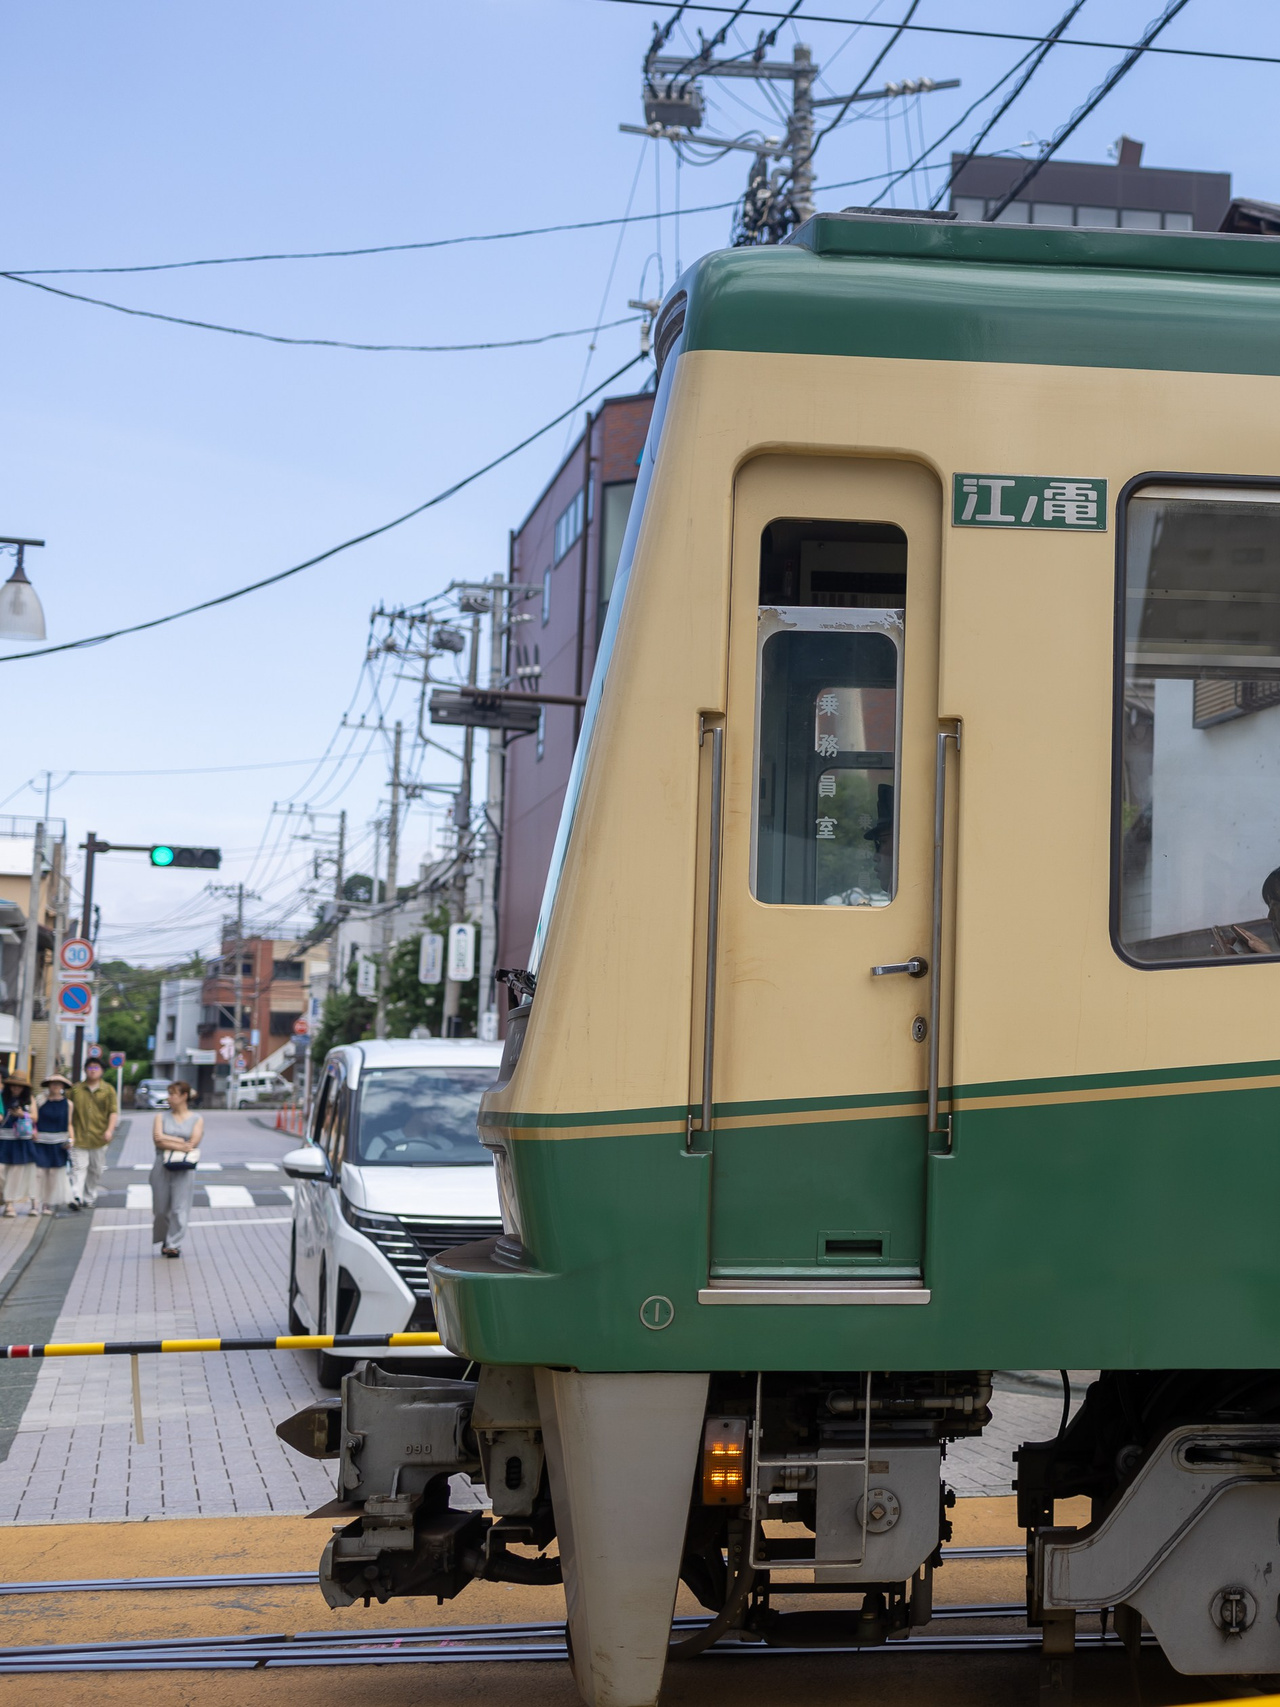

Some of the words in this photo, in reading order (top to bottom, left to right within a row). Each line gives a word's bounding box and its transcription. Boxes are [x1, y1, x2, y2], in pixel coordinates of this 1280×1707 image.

[961, 478, 1098, 525] 江ノ電
[815, 694, 840, 839] 乗務員室
[68, 946, 88, 962] 30
